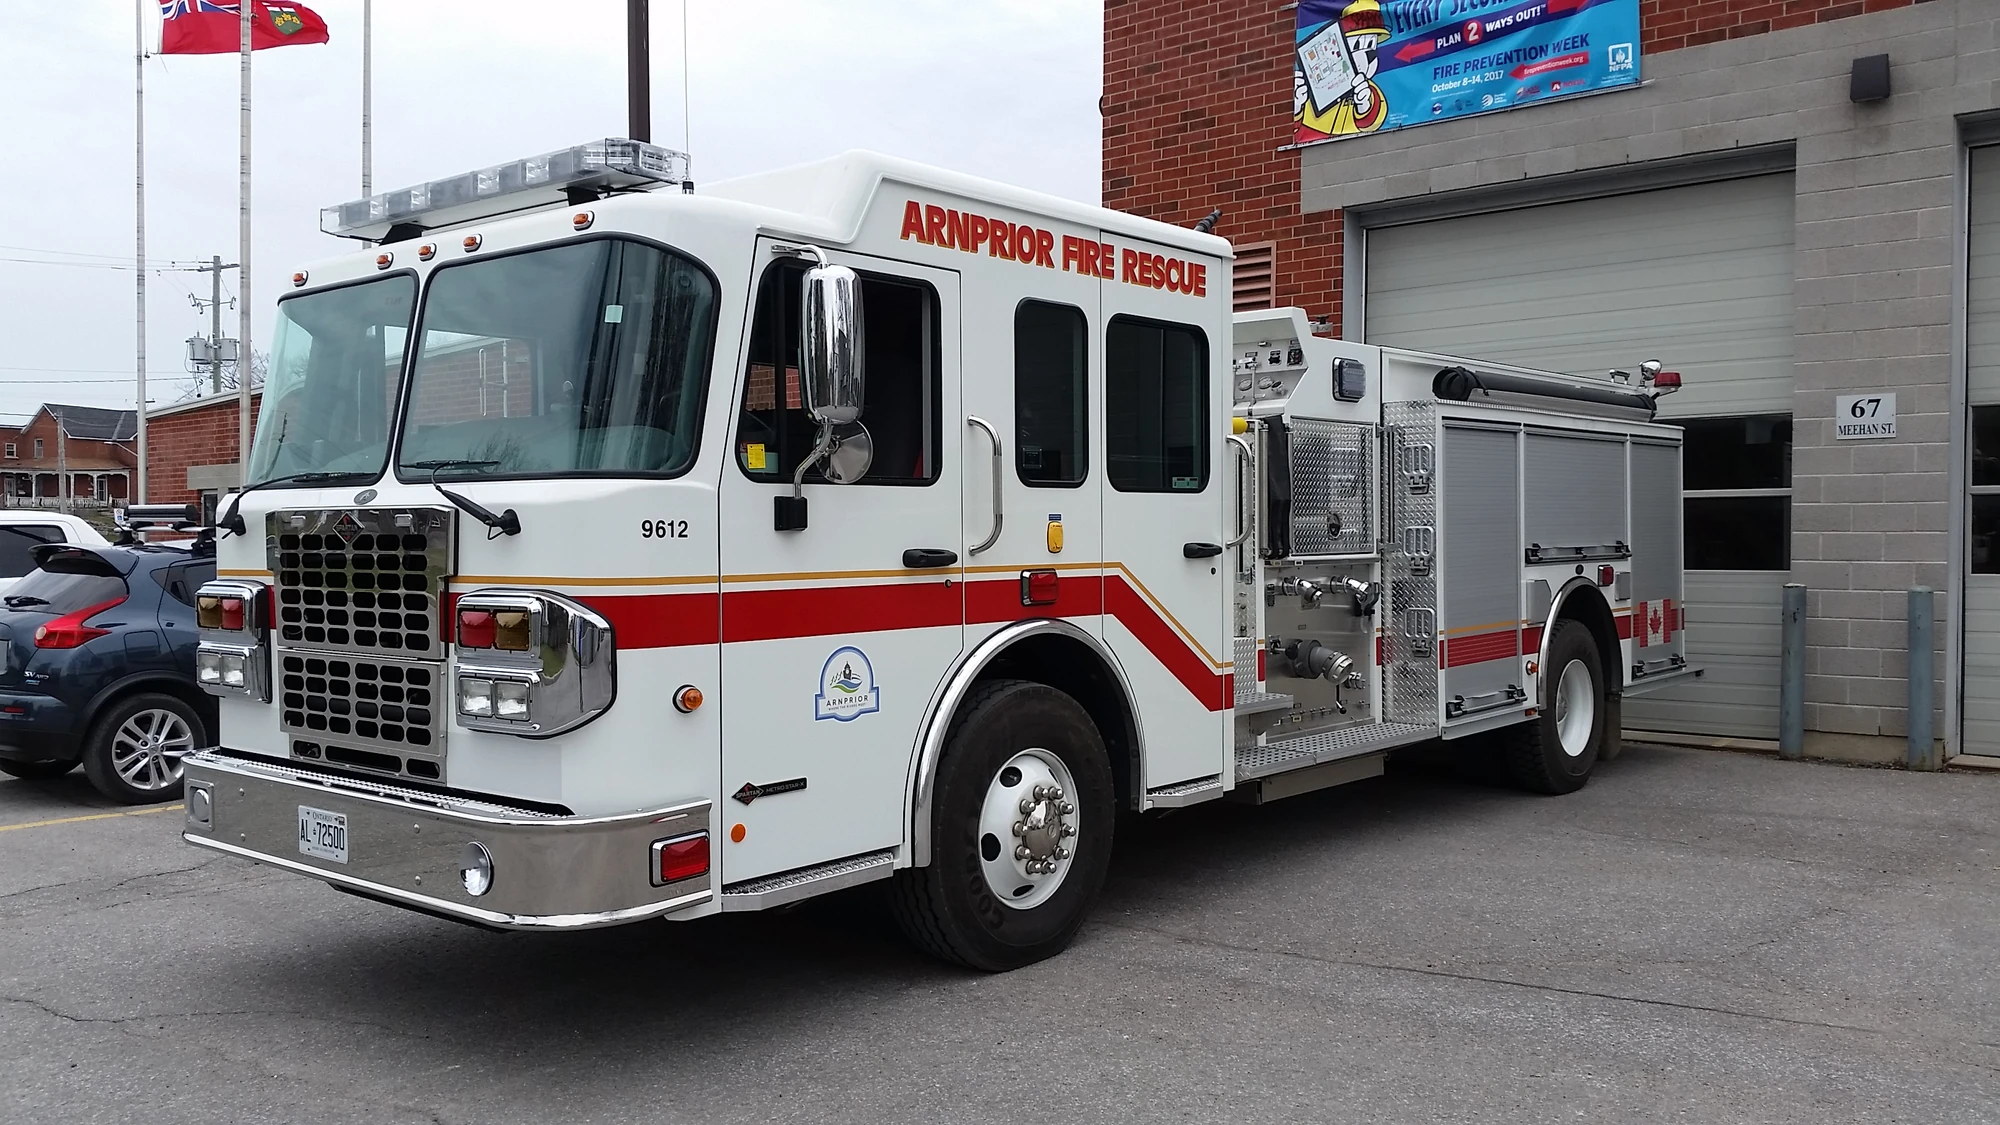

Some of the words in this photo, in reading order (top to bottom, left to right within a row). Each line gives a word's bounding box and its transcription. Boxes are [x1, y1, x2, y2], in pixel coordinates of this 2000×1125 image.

[1437, 32, 1461, 49] PLAN
[1467, 22, 1479, 41] 2
[1485, 15, 1513, 32] WAYS
[1433, 62, 1460, 80] FIRE
[1463, 44, 1549, 73] PREVENTION
[1552, 33, 1590, 53] WEEK
[1523, 55, 1584, 75] firepreventionweek.org
[1609, 62, 1633, 72] NFPA
[1432, 80, 1461, 93] October
[1484, 70, 1504, 82] 2017
[900, 200, 1055, 268] ARNPRIOR
[1062, 234, 1115, 280] FIRE
[1122, 247, 1206, 298] RESCUE
[1850, 398, 1882, 418] 67
[1838, 424, 1879, 436] MEEHAN
[1881, 422, 1895, 434] ST.
[641, 519, 688, 538] 9612
[826, 694, 869, 707] ARNPRIOR
[736, 789, 760, 799] SPARTAN
[300, 818, 312, 843] AL
[317, 821, 345, 851] 72500
